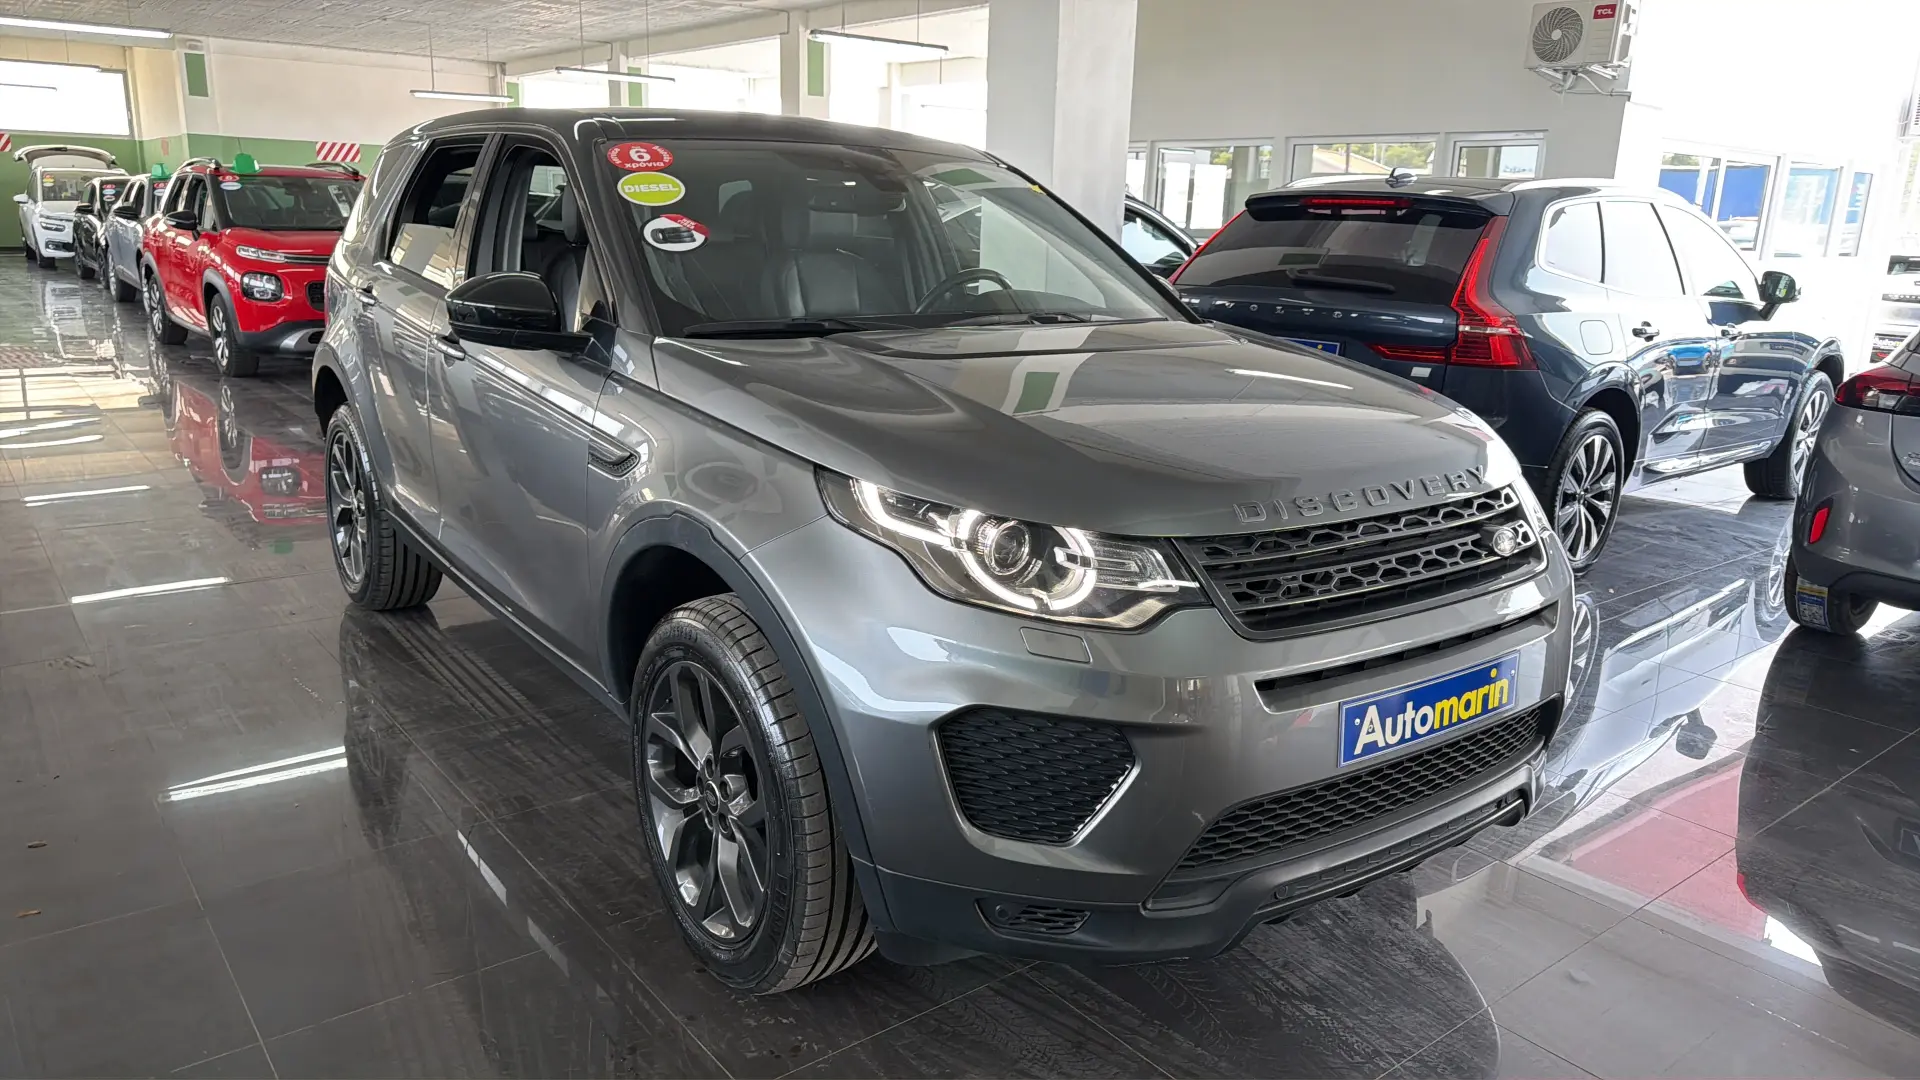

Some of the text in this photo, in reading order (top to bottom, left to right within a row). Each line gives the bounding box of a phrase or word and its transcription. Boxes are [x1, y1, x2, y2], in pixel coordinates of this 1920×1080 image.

[629, 148, 651, 162] 6
[623, 184, 679, 193] DIESEL
[1232, 464, 1486, 524] DISCOVERY
[1353, 667, 1510, 756] Automarin
